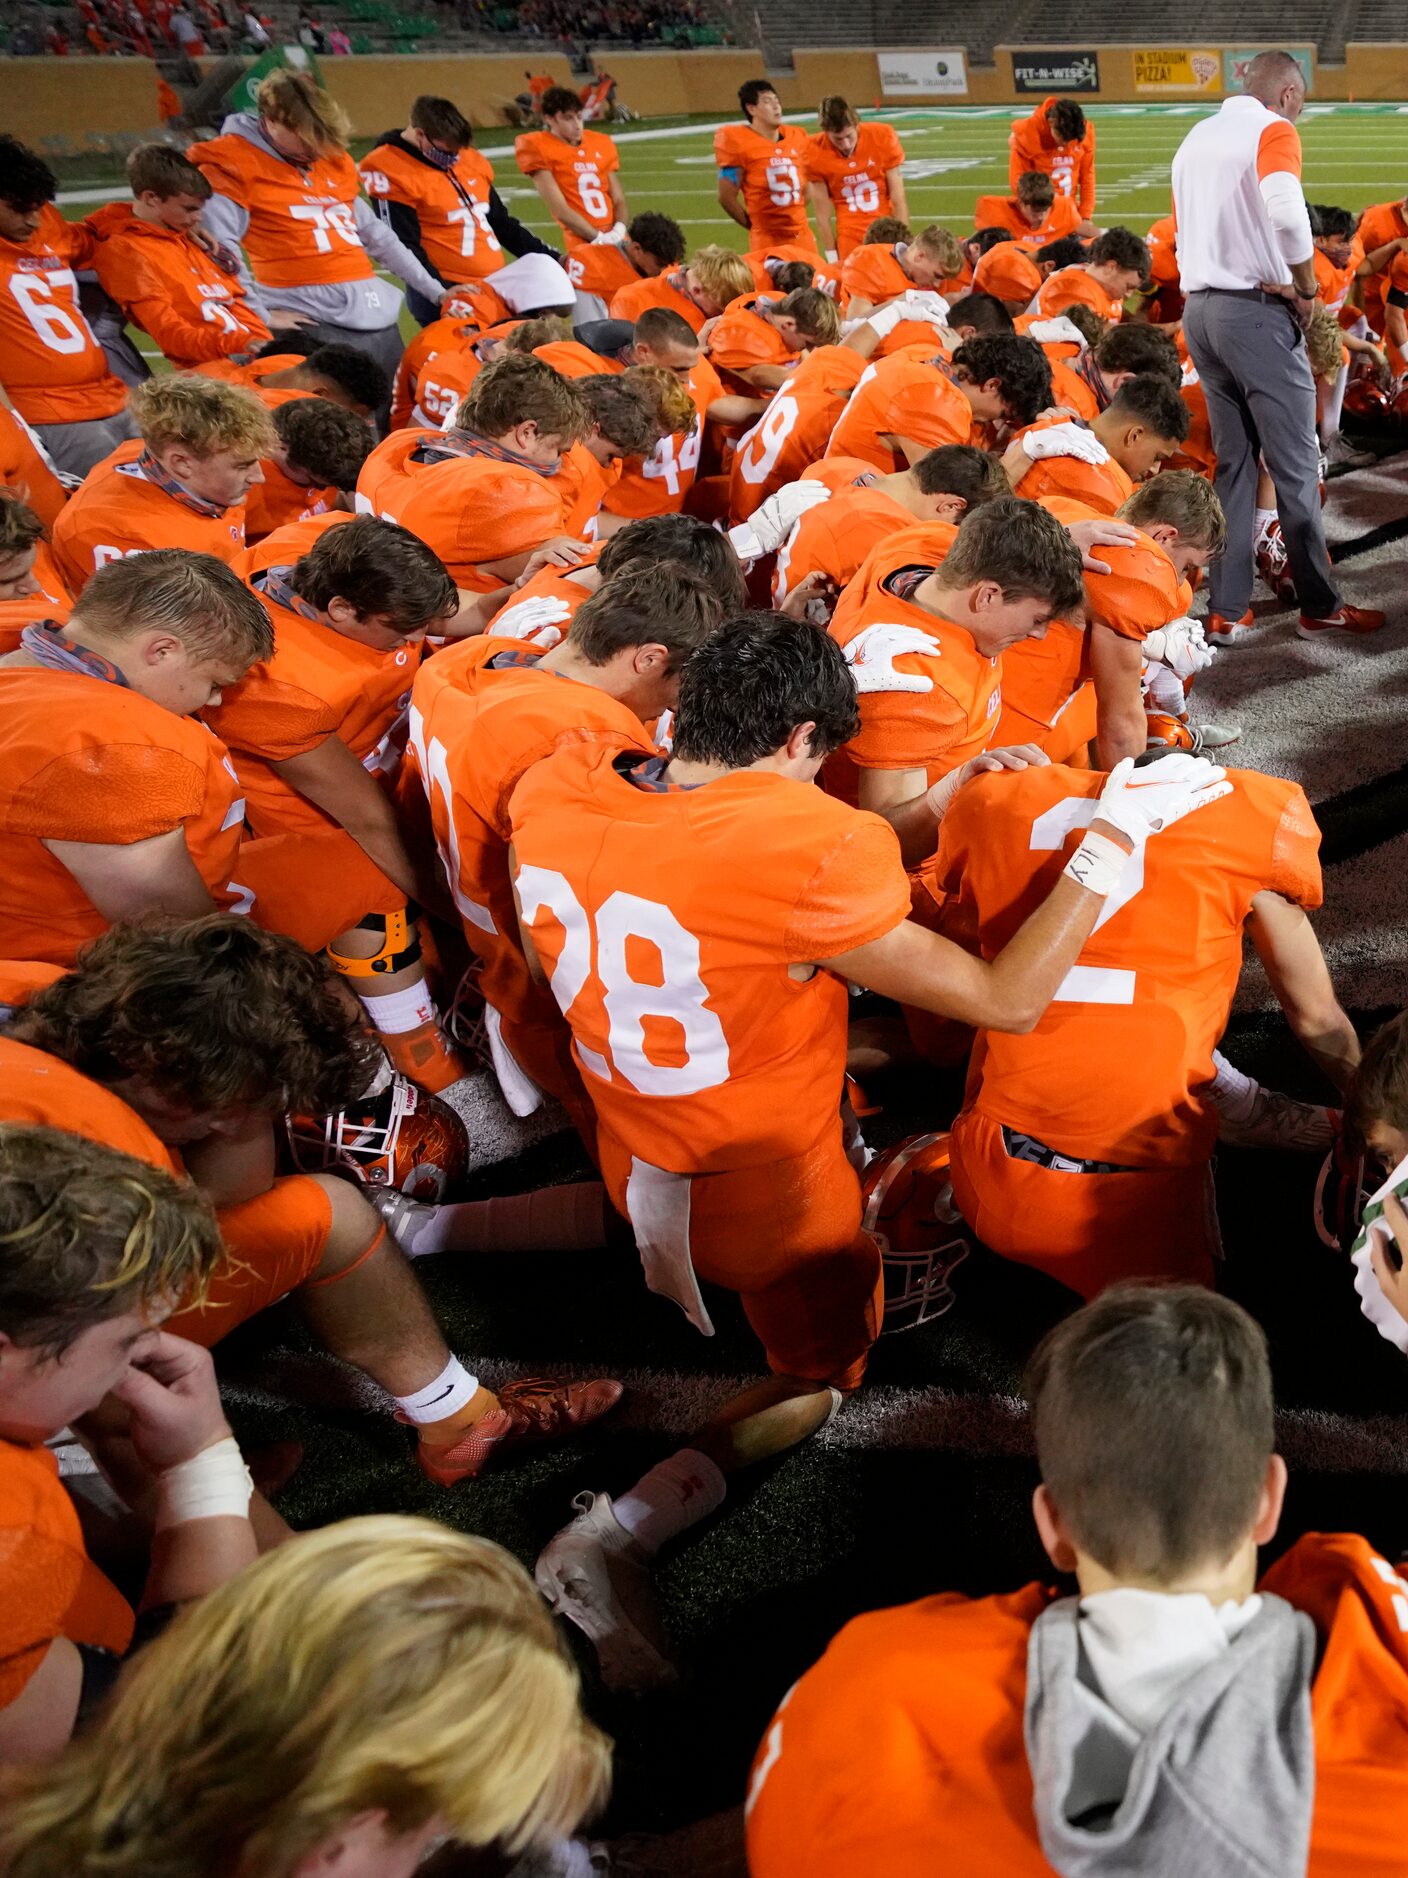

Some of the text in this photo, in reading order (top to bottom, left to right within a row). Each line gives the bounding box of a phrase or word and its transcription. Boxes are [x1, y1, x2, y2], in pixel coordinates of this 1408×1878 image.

[1015, 68, 1085, 79] FIT-N-WISE
[1136, 66, 1171, 81] PIZZA!
[1147, 52, 1186, 64] STADIUM
[360, 171, 390, 193] 79
[577, 173, 608, 219] 6
[766, 165, 800, 206] 51
[841, 181, 879, 213] 10
[9, 268, 101, 355] 67
[424, 380, 459, 413] 52
[643, 412, 701, 496] 44
